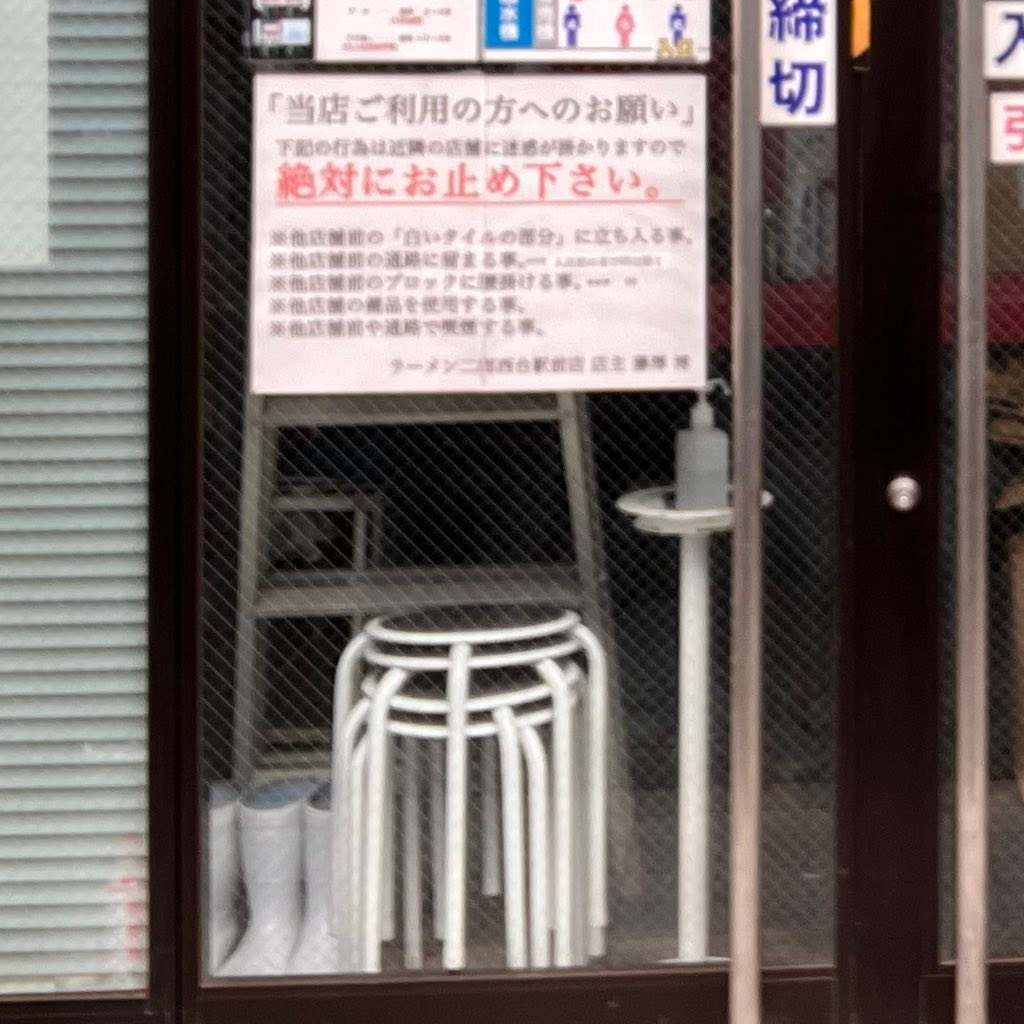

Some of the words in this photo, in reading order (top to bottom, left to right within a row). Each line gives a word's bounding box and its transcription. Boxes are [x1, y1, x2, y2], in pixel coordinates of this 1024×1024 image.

[266, 92, 696, 127] 「当店ご利用の方へのお願い」
[276, 161, 662, 200] 絶対にお止め下さい。
